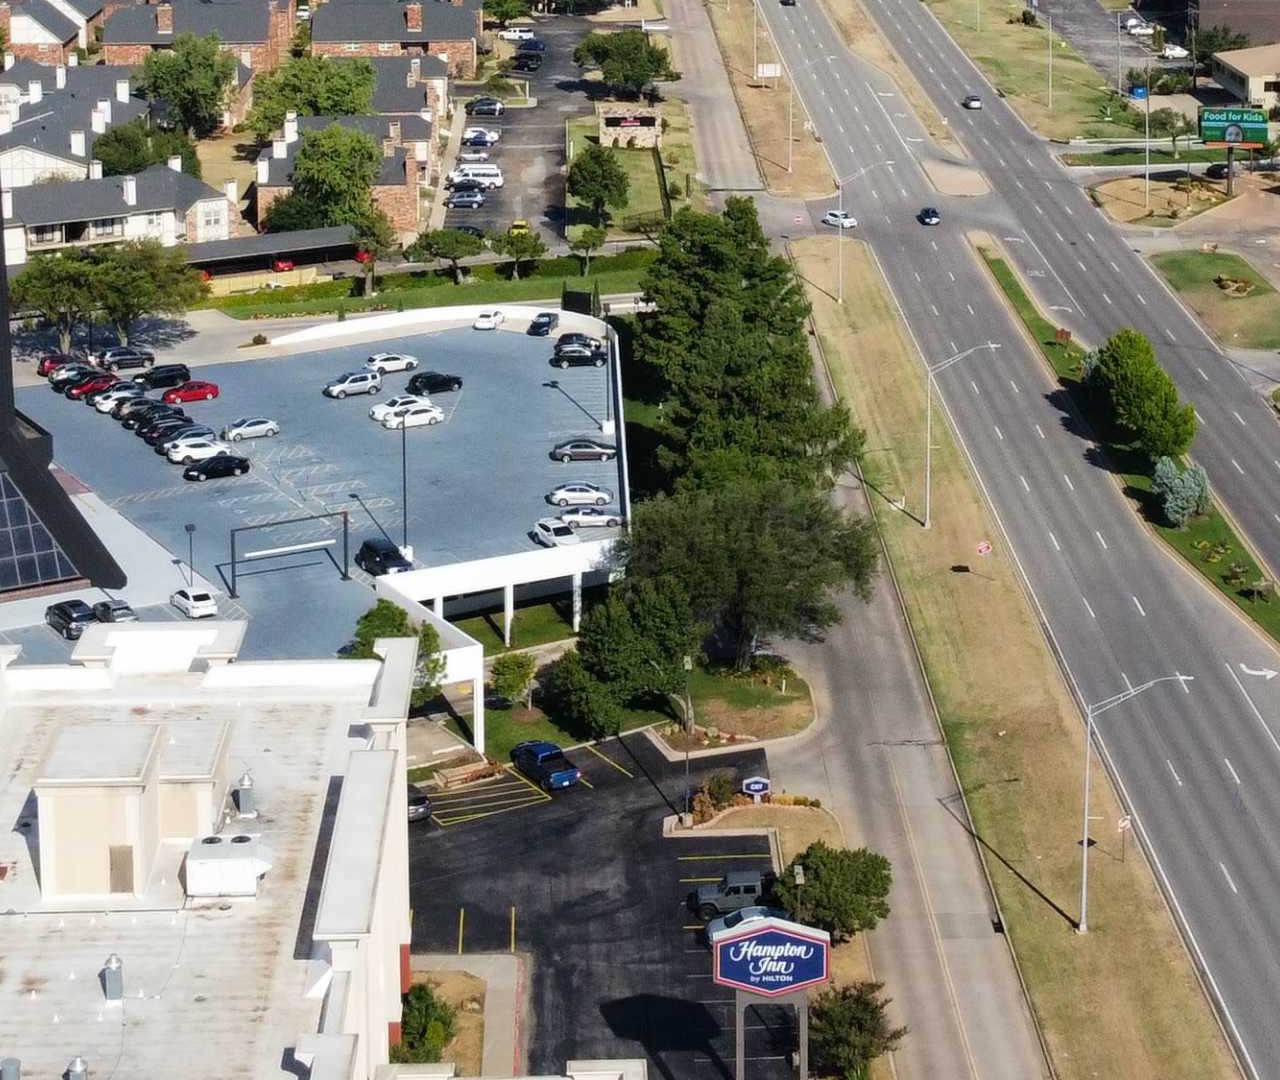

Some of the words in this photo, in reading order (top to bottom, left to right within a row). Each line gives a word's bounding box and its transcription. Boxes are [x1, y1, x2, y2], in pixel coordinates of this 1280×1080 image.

[1204, 112, 1227, 120] Food
[1229, 112, 1241, 120] for
[1243, 112, 1264, 121] Kids
[730, 941, 814, 961] Hampton
[749, 957, 794, 975] Inn
